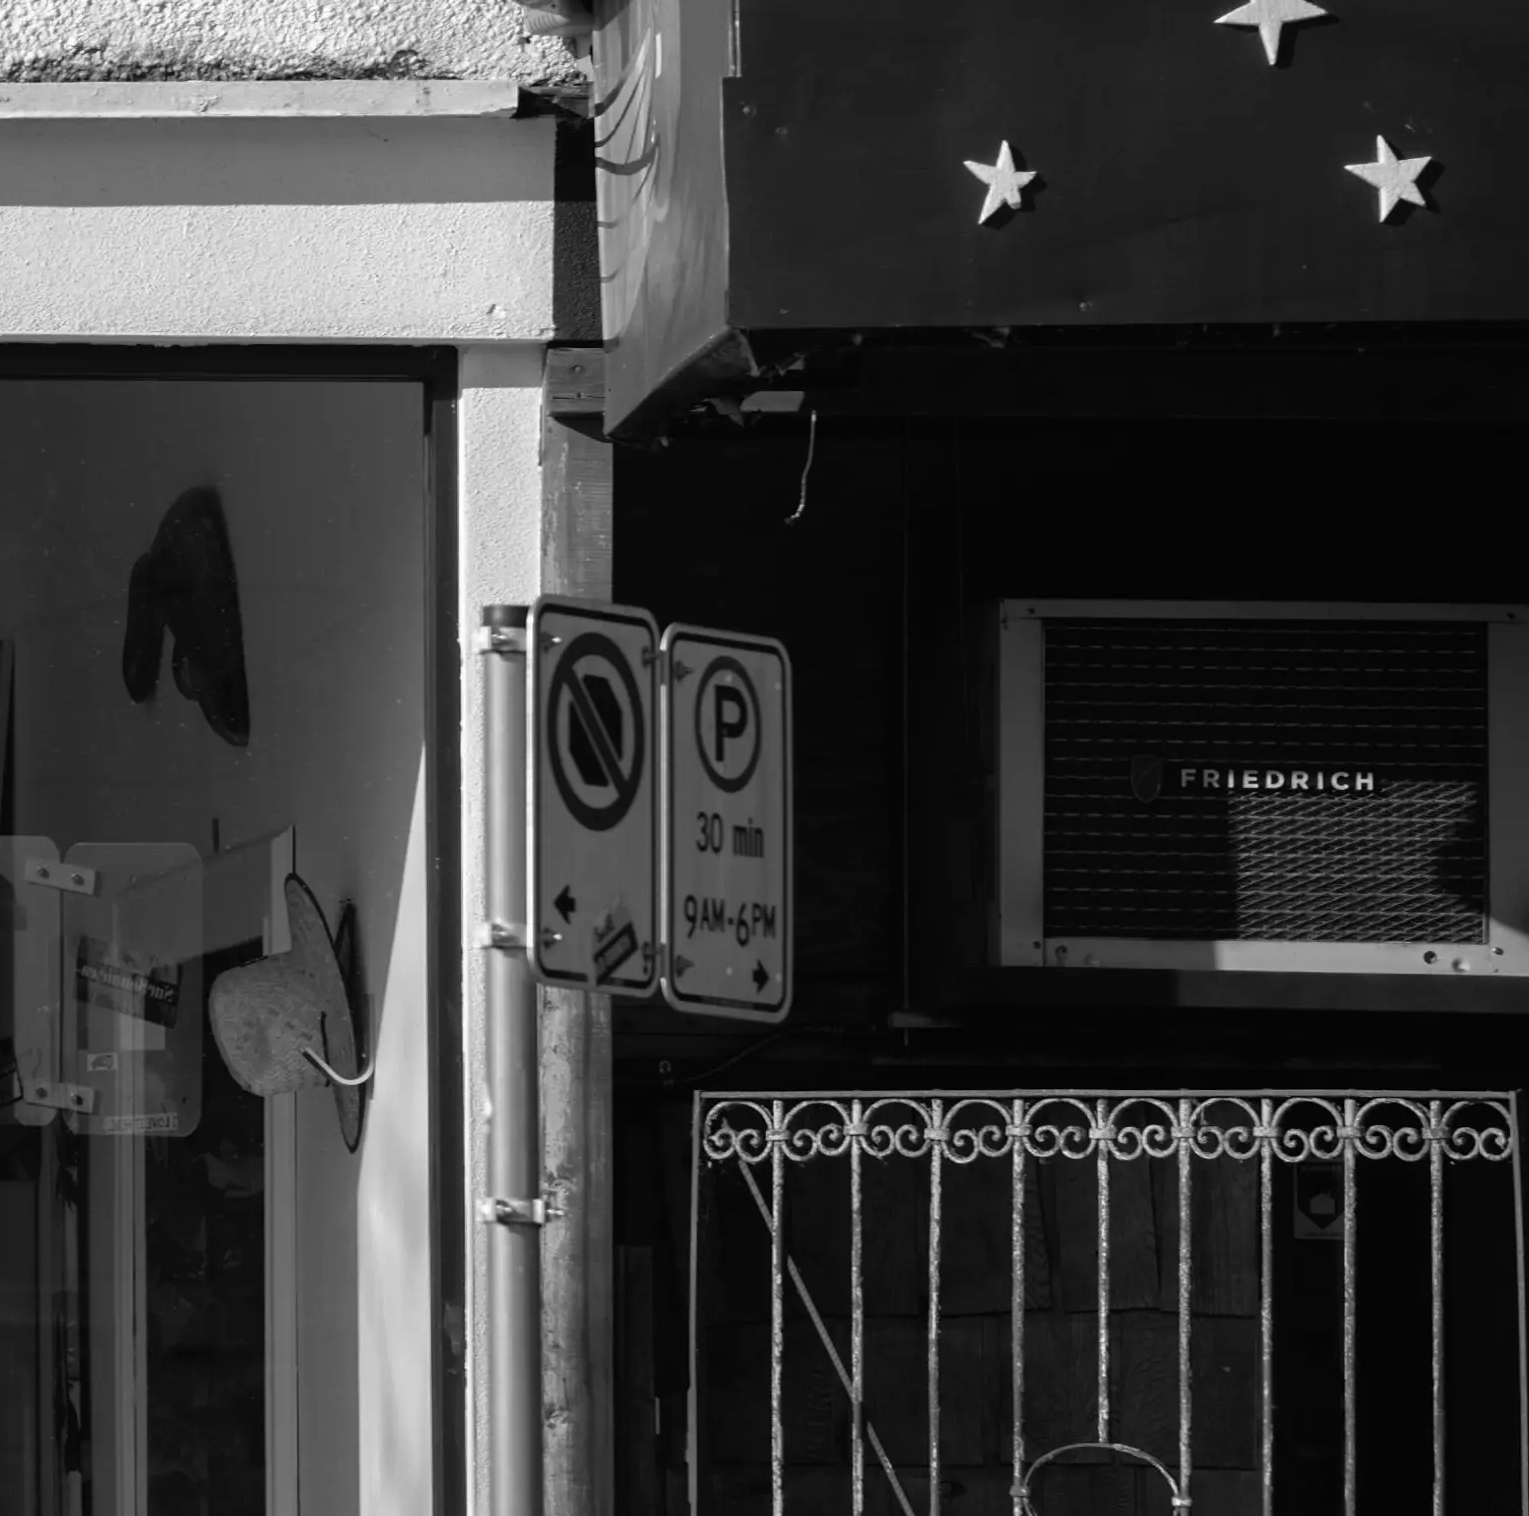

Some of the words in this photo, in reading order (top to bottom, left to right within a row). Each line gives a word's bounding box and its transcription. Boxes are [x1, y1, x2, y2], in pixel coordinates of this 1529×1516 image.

[713, 684, 749, 763] P
[1180, 768, 1376, 792] FRIEDRICH
[695, 811, 723, 855] 30
[732, 817, 766, 859] min
[683, 893, 777, 948] 9AM-6PM
